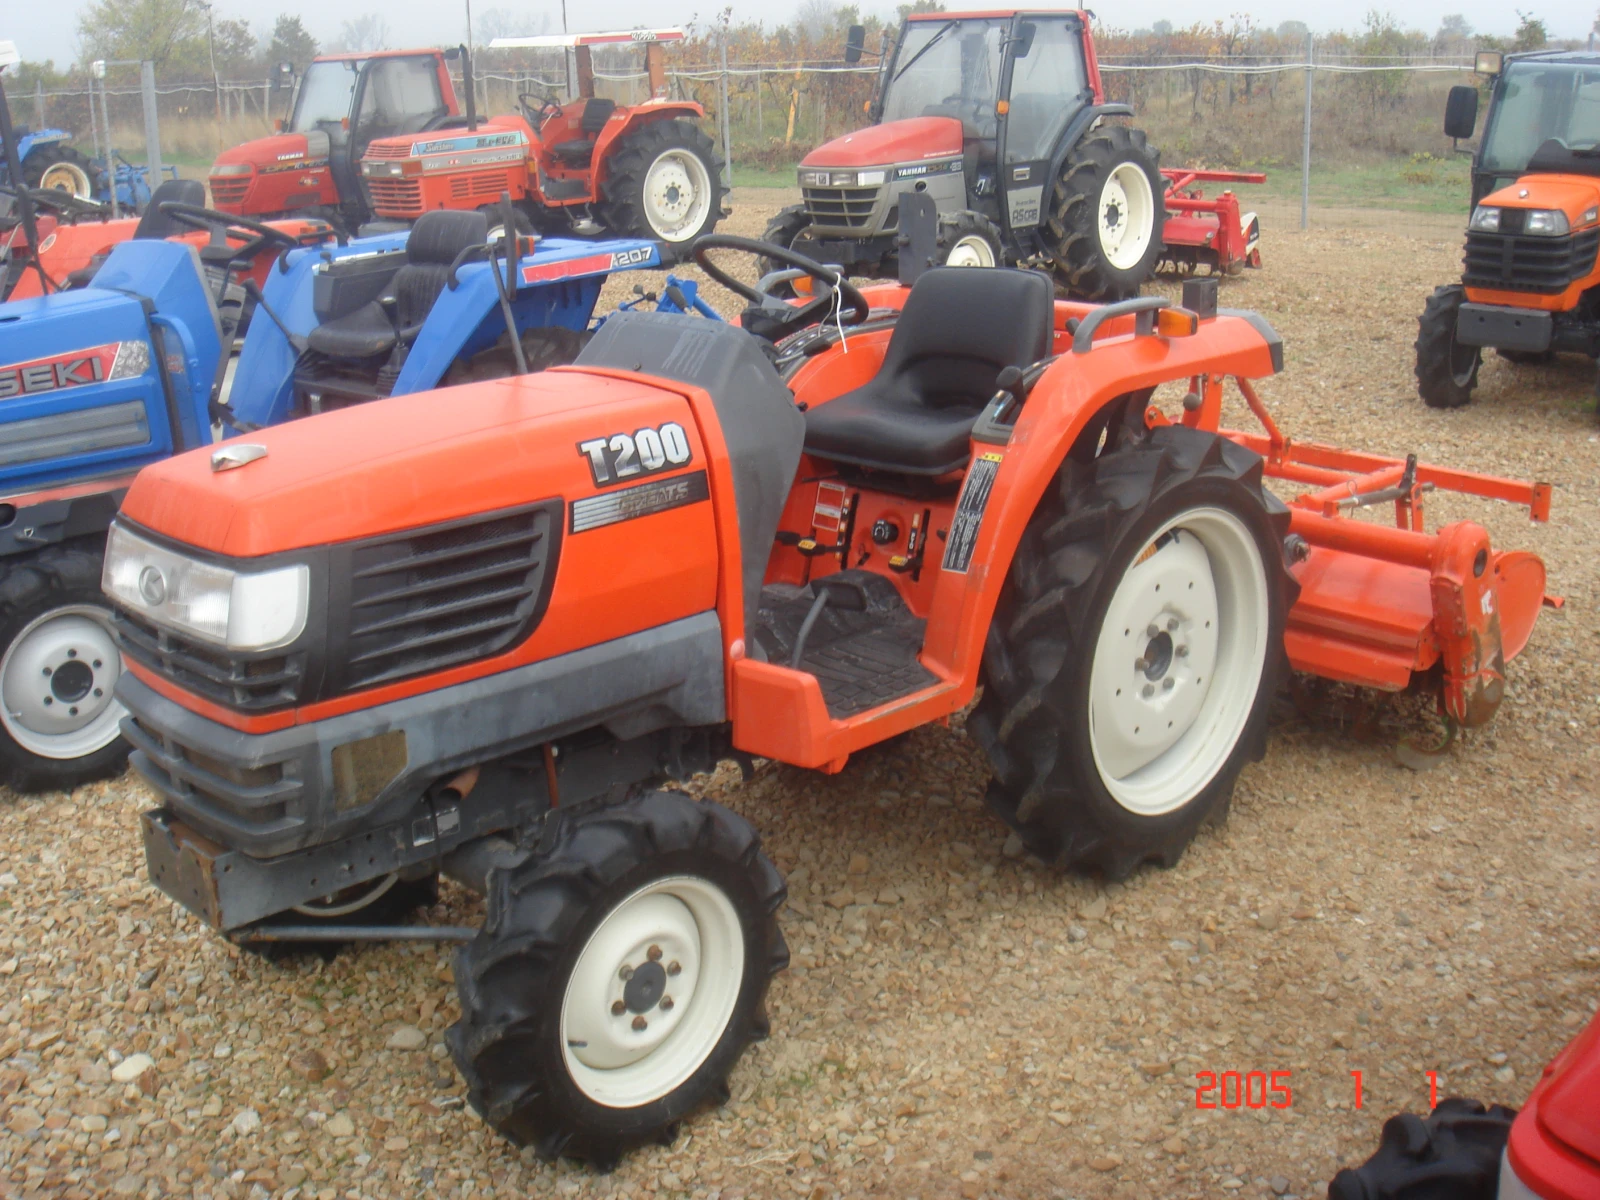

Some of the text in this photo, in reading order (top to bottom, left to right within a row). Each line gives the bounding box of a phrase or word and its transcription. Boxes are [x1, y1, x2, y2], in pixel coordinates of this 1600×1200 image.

[277, 152, 304, 161] YANMAR
[898, 166, 927, 177] YANMAR
[578, 422, 691, 485] T200
